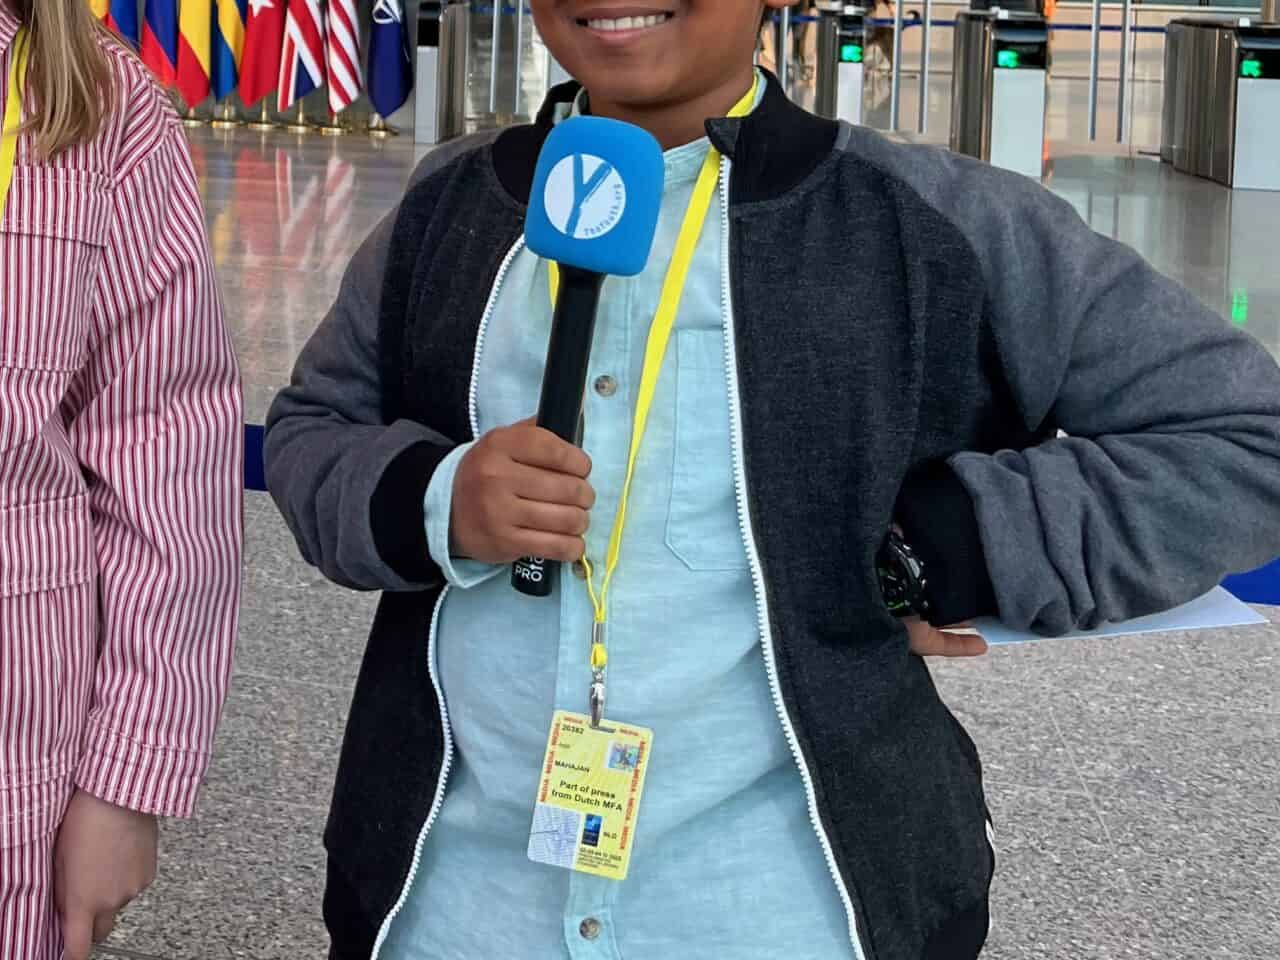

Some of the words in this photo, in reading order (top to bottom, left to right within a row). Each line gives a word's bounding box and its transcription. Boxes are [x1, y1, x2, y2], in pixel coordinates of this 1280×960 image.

[515, 565, 543, 582] PRO
[560, 780, 578, 791] Part
[580, 785, 590, 793] of
[591, 788, 616, 799] press
[551, 789, 572, 800] from
[574, 794, 600, 807] Dutch
[602, 800, 623, 811] MFA
